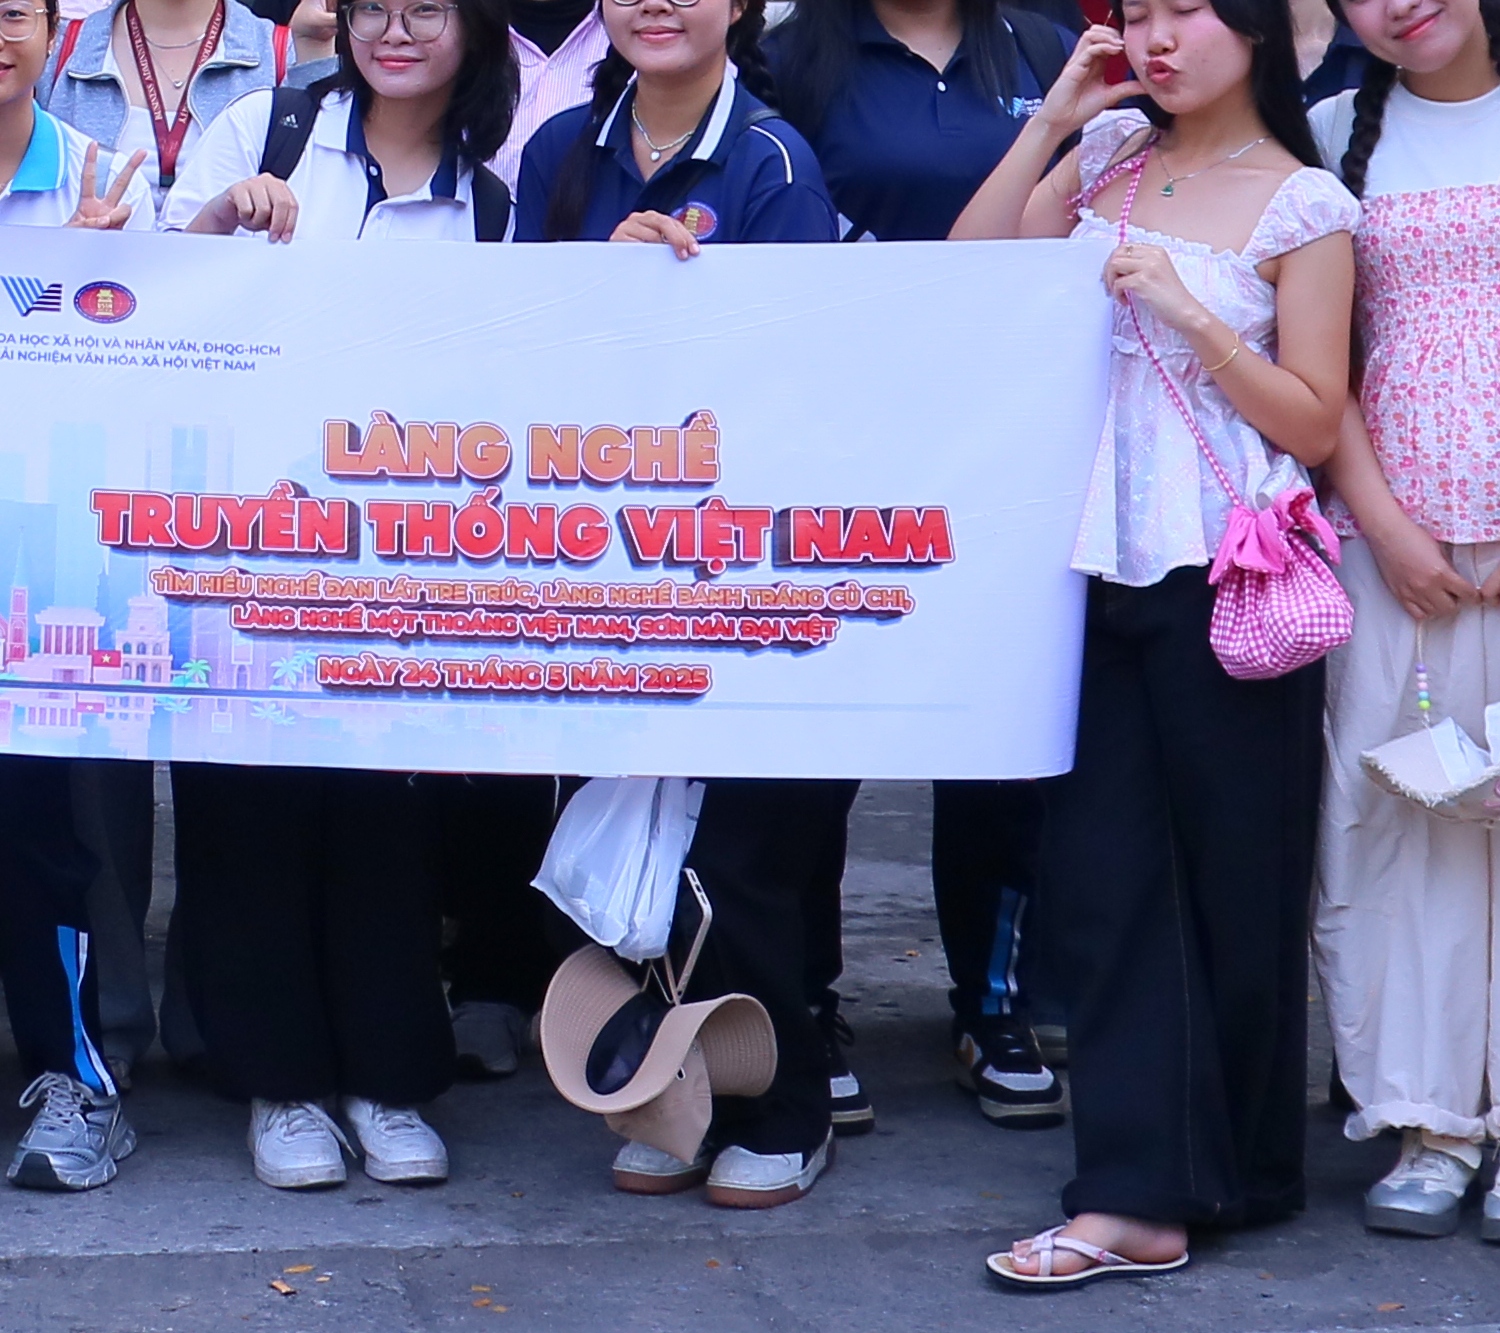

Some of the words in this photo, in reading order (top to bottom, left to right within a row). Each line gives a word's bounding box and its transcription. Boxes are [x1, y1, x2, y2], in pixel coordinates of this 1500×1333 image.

[18, 350, 71, 365] NGHIỆM
[75, 351, 104, 364] VĂN
[108, 353, 138, 366] HÓA
[141, 354, 159, 367] XÃ
[164, 355, 188, 370] HỘI
[192, 357, 221, 372] VIỆT
[224, 360, 255, 371] NAM
[20, 334, 50, 347] HỌC
[53, 333, 71, 347] XÃ
[75, 335, 98, 350] HỘI
[102, 336, 122, 349] VÀ
[125, 338, 164, 350] NHÂN
[168, 338, 200, 353] VĂN,
[203, 342, 280, 356] ĐHQG-HCM
[323, 411, 510, 479] LÀNG
[529, 409, 722, 483] NGHỀ
[91, 481, 353, 555] TRUYỀN
[367, 487, 610, 560] THỐNG
[621, 498, 774, 577] VIỆT
[783, 505, 955, 565] NAM
[153, 570, 194, 595] TÌM
[200, 568, 252, 596] HIỂU
[257, 571, 320, 598] NGHỀ
[325, 581, 375, 600] ĐAN
[379, 576, 424, 602] LÁT
[425, 581, 469, 602] TRE
[473, 579, 539, 606] TRÚC,
[542, 579, 604, 606] LÀNG
[609, 579, 674, 607] NGHỀ
[678, 583, 742, 608] BÁNH
[747, 583, 825, 609] TRÁNG
[828, 582, 860, 610] CỦ
[232, 603, 296, 629] LÀNG
[300, 603, 365, 631] NGHỀ
[368, 609, 421, 637] MỘT
[422, 609, 517, 634] THOÁNG
[522, 612, 574, 641] VIỆT
[575, 616, 635, 642] NAM,
[637, 614, 687, 638] SƠN
[692, 614, 737, 639] MÀI
[739, 616, 783, 643] ĐẠI
[785, 614, 838, 642] VIỆT
[318, 654, 400, 685] NGÀY
[400, 660, 438, 686] 24
[442, 656, 542, 689] THÁNG
[546, 664, 567, 691] 5
[571, 660, 639, 691] NĂM
[642, 664, 711, 692] 2025
